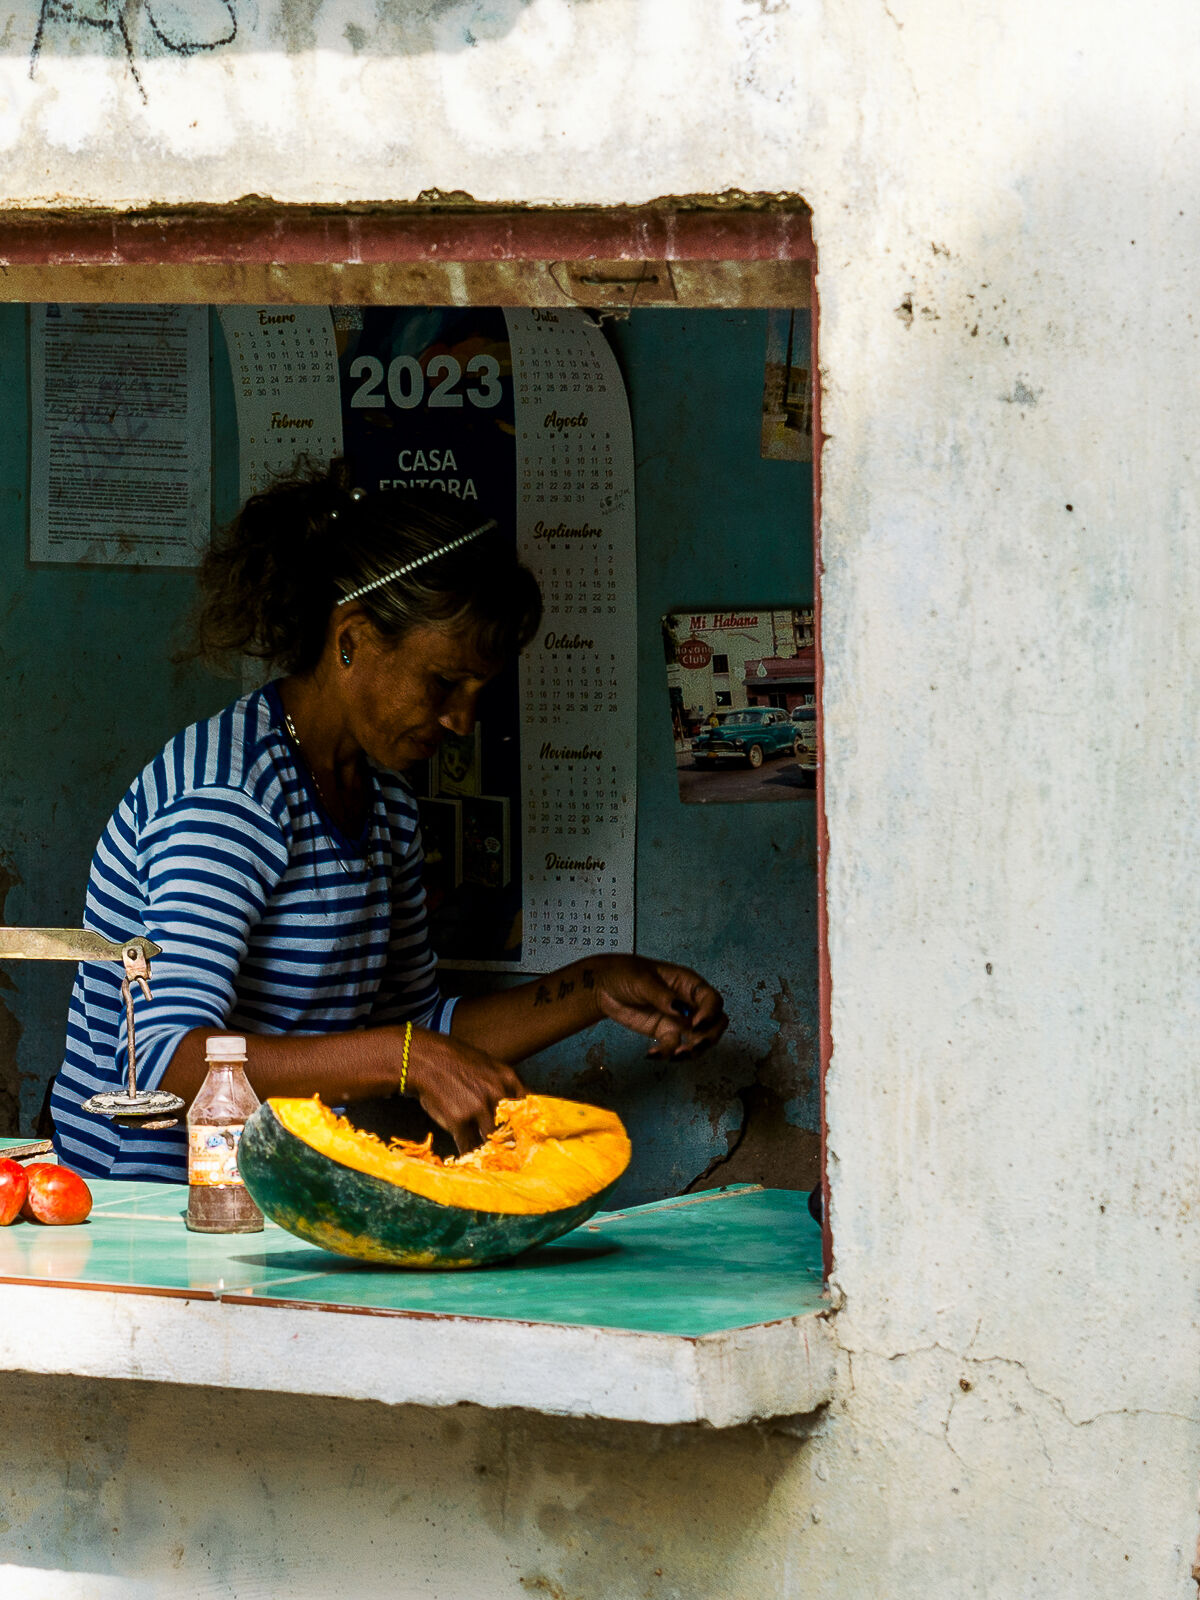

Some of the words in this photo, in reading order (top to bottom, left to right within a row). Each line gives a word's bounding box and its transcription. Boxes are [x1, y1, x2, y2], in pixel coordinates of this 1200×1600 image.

[256, 309, 296, 326] Enero
[267, 351, 276, 359] 10
[281, 351, 289, 359] 11
[296, 351, 304, 359] 12
[310, 350, 319, 358] 13
[324, 350, 333, 358] 14
[240, 365, 249, 373] 15
[255, 364, 264, 372] 16
[269, 363, 278, 371] 17
[283, 363, 292, 371] 18
[297, 363, 306, 371] 19
[311, 363, 320, 371] 20
[325, 362, 334, 370] 21
[241, 377, 250, 385] 22
[256, 376, 265, 384] 23
[270, 376, 279, 384] 24
[284, 375, 293, 383] 25
[298, 375, 307, 383] 26
[312, 375, 321, 383] 27
[326, 375, 335, 383] 28
[349, 354, 503, 409] 2023
[243, 389, 252, 397] 29
[258, 388, 267, 396] 30
[271, 388, 280, 396] 31
[533, 384, 542, 392] 24
[546, 384, 555, 392] 25
[559, 384, 568, 392] 26
[572, 384, 581, 392] 27
[270, 411, 314, 429] Febrero
[543, 410, 589, 432] Agosto
[398, 449, 457, 472] CASA
[577, 457, 586, 465] 10
[590, 457, 599, 465] 11
[604, 457, 613, 465] 12
[536, 469, 545, 477] 14
[550, 469, 559, 477] 15
[563, 469, 572, 477] 16
[577, 469, 586, 477] 17
[590, 469, 599, 477] 18
[605, 469, 614, 477] 19
[522, 482, 531, 490] 20
[535, 482, 544, 490] 21
[549, 482, 558, 490] 22
[563, 482, 572, 490] 23
[576, 482, 585, 490] 24
[590, 482, 599, 490] 25
[604, 482, 613, 490] 26
[522, 494, 531, 502] 27
[536, 495, 545, 503] 28
[550, 495, 559, 503] 29
[563, 495, 572, 503] 30
[576, 495, 585, 503] 31
[533, 520, 603, 543] Septiembre
[551, 580, 560, 588] 12
[578, 580, 587, 588] 14
[592, 580, 601, 588] 15
[607, 581, 616, 589] 16
[551, 593, 560, 601] 19
[564, 593, 573, 601] 20
[578, 593, 587, 601] 21
[592, 593, 601, 601] 22
[607, 593, 616, 601] 23
[550, 605, 559, 613] 26
[564, 605, 573, 613] 27
[578, 606, 587, 614] 28
[593, 606, 602, 614] 29
[607, 606, 616, 614] 30
[690, 616, 706, 629] Mi
[713, 613, 758, 628] Habana
[544, 632, 594, 650] Octubre
[682, 655, 706, 664] Club
[552, 678, 561, 686] 10
[566, 679, 574, 687] 11
[580, 679, 589, 687] 12
[594, 679, 603, 687] 13
[609, 679, 618, 687] 14
[594, 691, 603, 699] 20
[608, 691, 617, 699] 21
[539, 742, 603, 760] Noviembre
[545, 852, 607, 871] Diciembre
[529, 911, 538, 919] 10
[542, 911, 551, 919] 11
[556, 912, 565, 920] 12
[569, 912, 578, 920] 13
[583, 912, 592, 920] 14
[596, 913, 605, 921] 15
[610, 913, 619, 921] 16
[529, 923, 538, 931] 17
[543, 924, 552, 932] 18
[556, 924, 565, 932] 19
[569, 925, 578, 933] 20
[582, 925, 591, 933] 21
[596, 925, 605, 933] 22
[610, 926, 619, 934] 23
[528, 936, 537, 944] 24
[542, 936, 551, 944] 25
[555, 937, 564, 945] 26
[569, 937, 578, 945] 27
[582, 938, 591, 946] 28
[596, 938, 605, 946] 29
[610, 939, 619, 947] 30
[527, 948, 536, 956] 31
